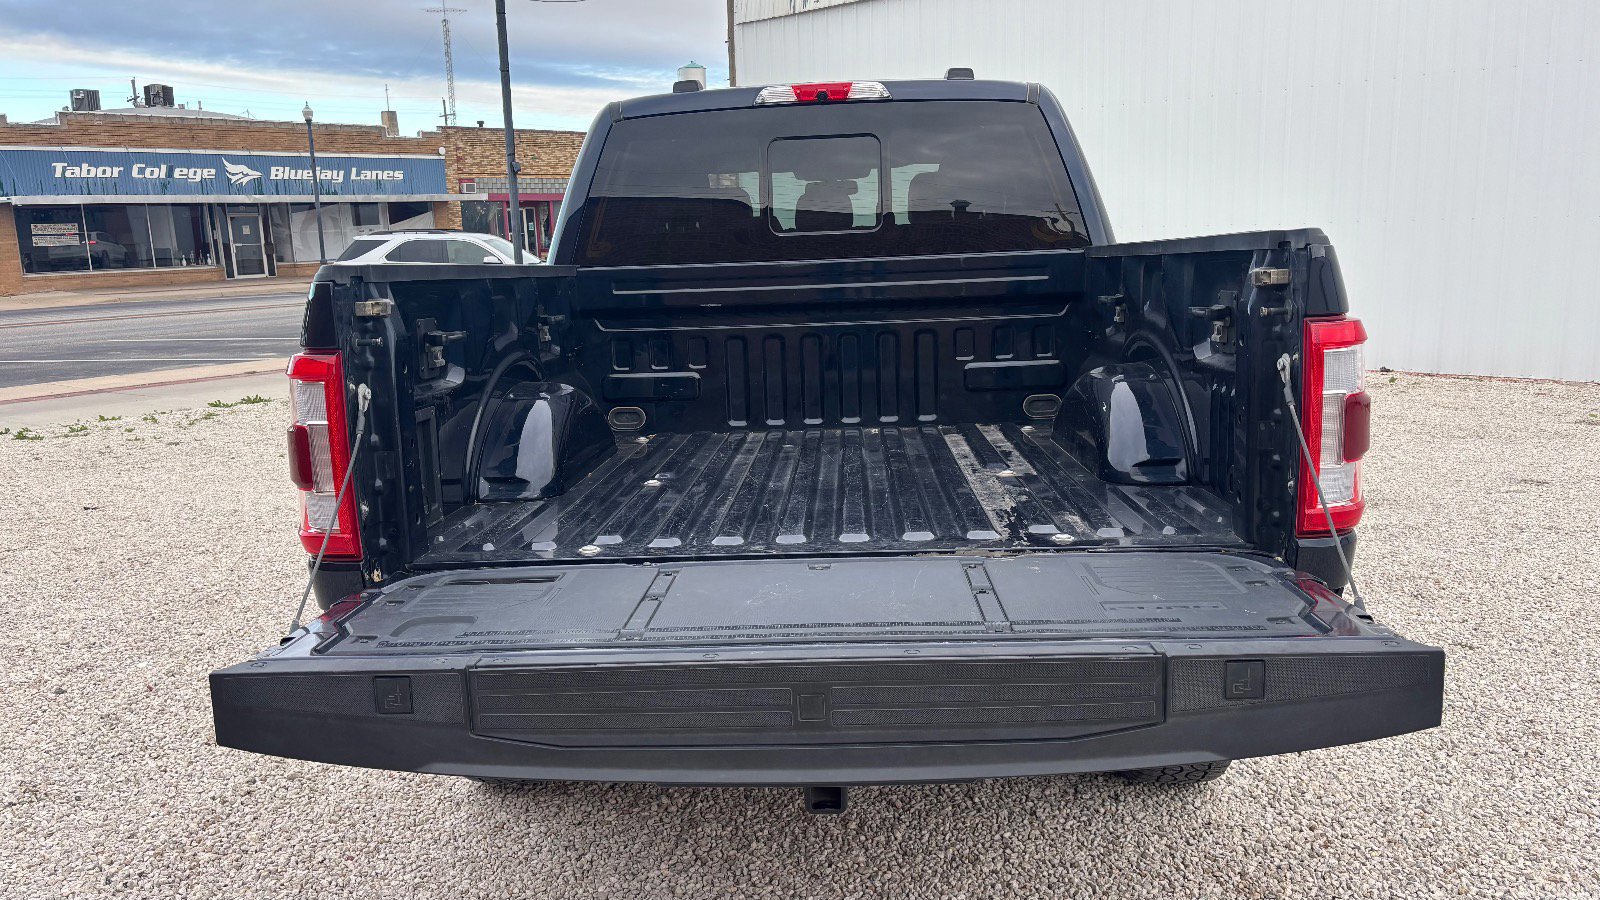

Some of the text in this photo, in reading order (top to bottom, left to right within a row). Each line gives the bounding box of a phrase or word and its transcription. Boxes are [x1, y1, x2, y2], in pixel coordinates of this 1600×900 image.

[51, 162, 124, 179] Tabor
[270, 166, 404, 184] Bluejay Lanes
